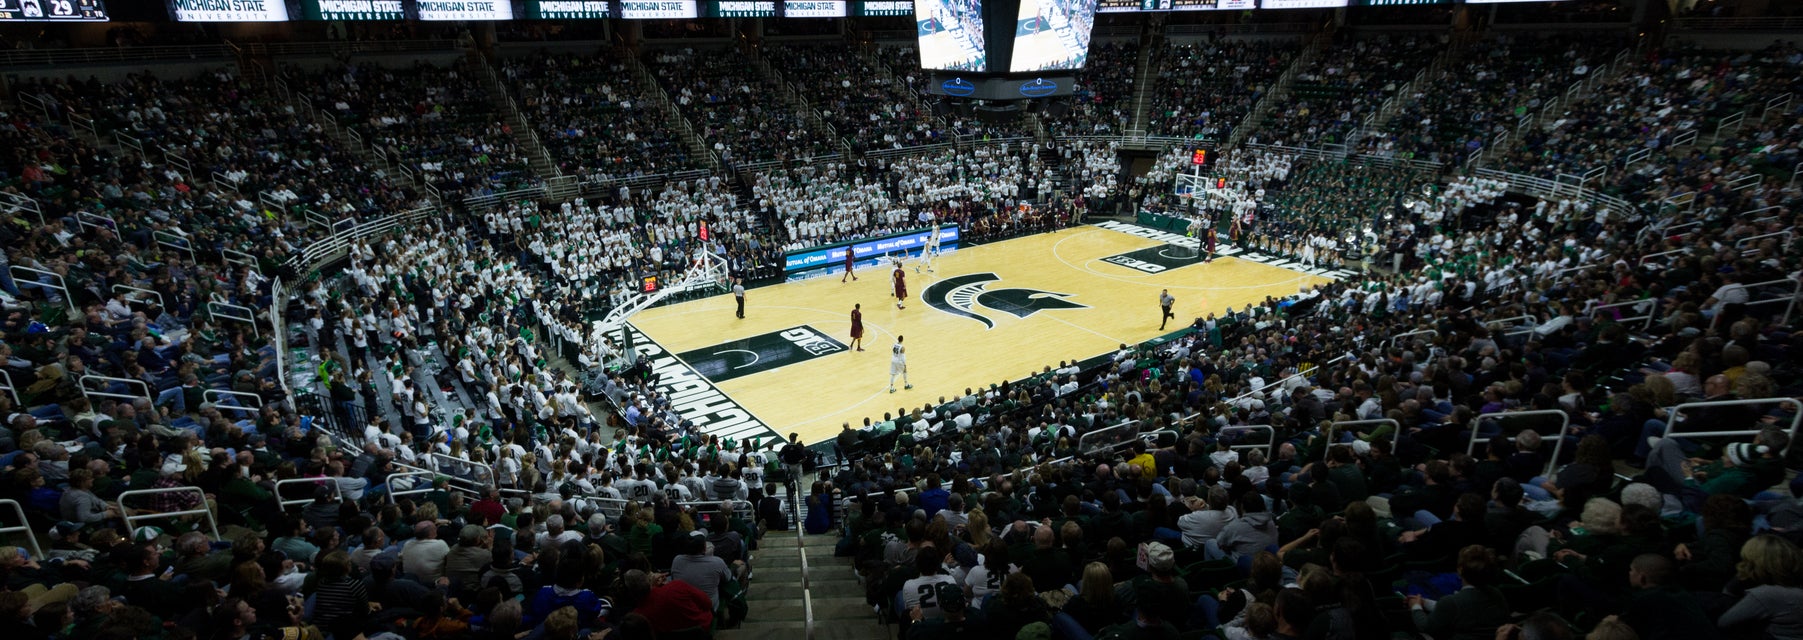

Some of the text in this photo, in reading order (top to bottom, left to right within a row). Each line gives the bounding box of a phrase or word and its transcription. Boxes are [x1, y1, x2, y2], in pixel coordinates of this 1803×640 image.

[50, 0, 73, 15] 29
[174, 0, 267, 11] MICHIGAN STATE
[318, 0, 404, 12] MICHIGAN STATE
[417, 2, 495, 11] MICHIGAN STATE
[538, 1, 609, 12] MICHIGAN STATE
[620, 2, 683, 11] MICHIGAN STATE
[718, 1, 775, 11] MICHIGAN STATE
[784, 2, 835, 10] MICHIGAN STATE
[864, 1, 913, 10] MICHIGAN STATE
[810, 254, 827, 263] OMAHA
[535, 446, 544, 459] 20
[745, 472, 758, 482] 20
[634, 485, 649, 497] 20
[665, 488, 680, 500] 20
